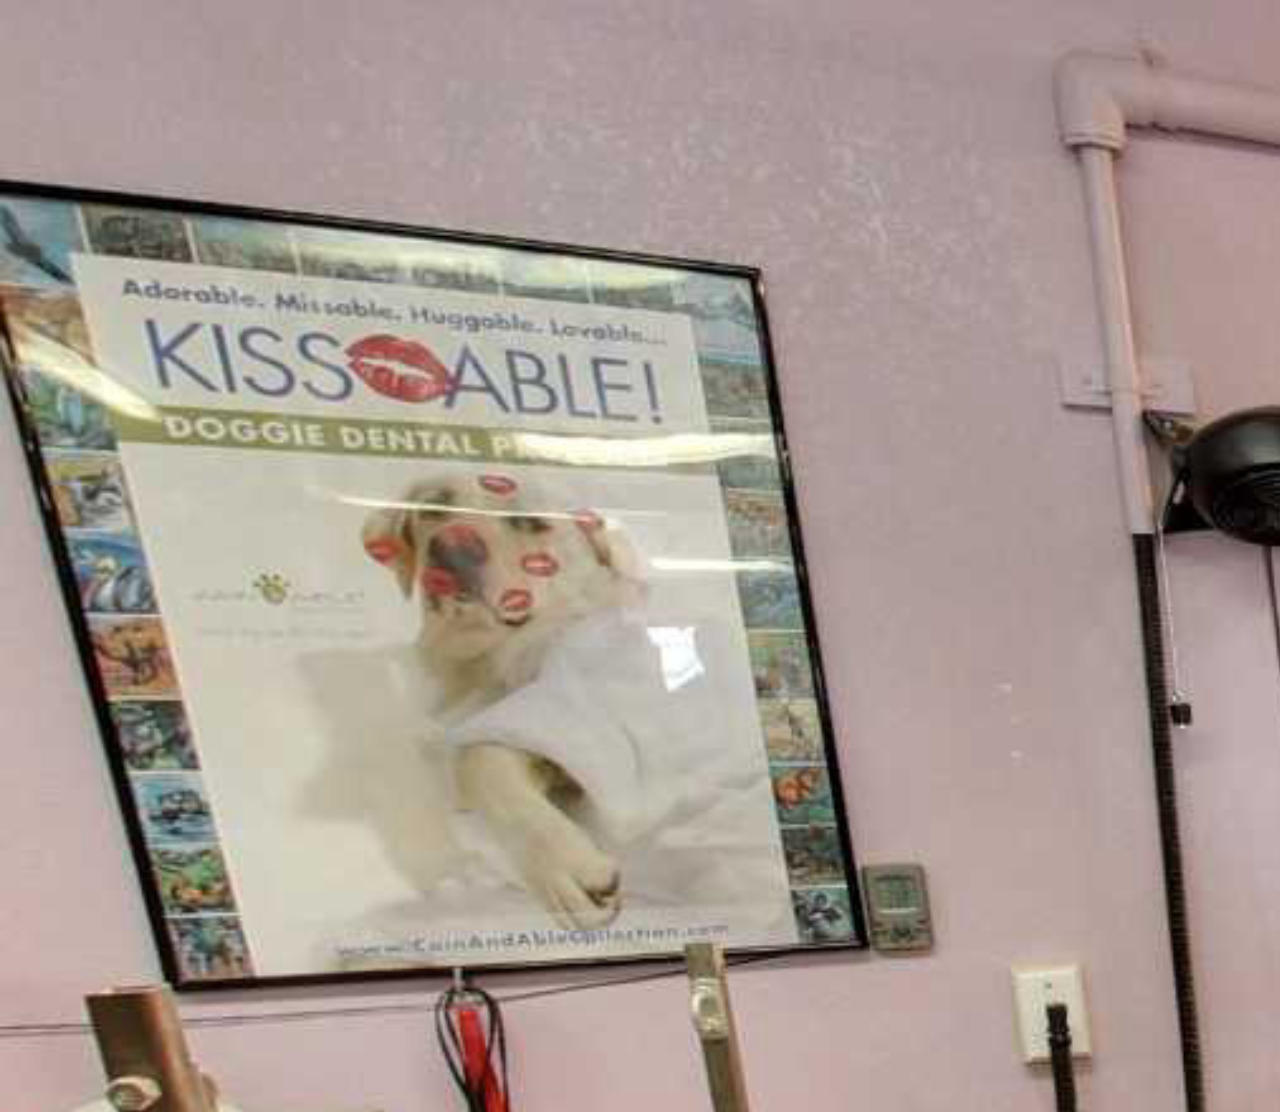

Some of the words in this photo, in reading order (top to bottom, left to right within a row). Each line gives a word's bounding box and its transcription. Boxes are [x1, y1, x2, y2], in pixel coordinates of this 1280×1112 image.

[122, 279, 264, 308] Adorable.
[274, 293, 402, 320] Missable.
[145, 319, 354, 401] KISS
[444, 342, 663, 424] ABLE!
[163, 416, 326, 446] DOGGIE
[339, 425, 482, 455] DENTAL
